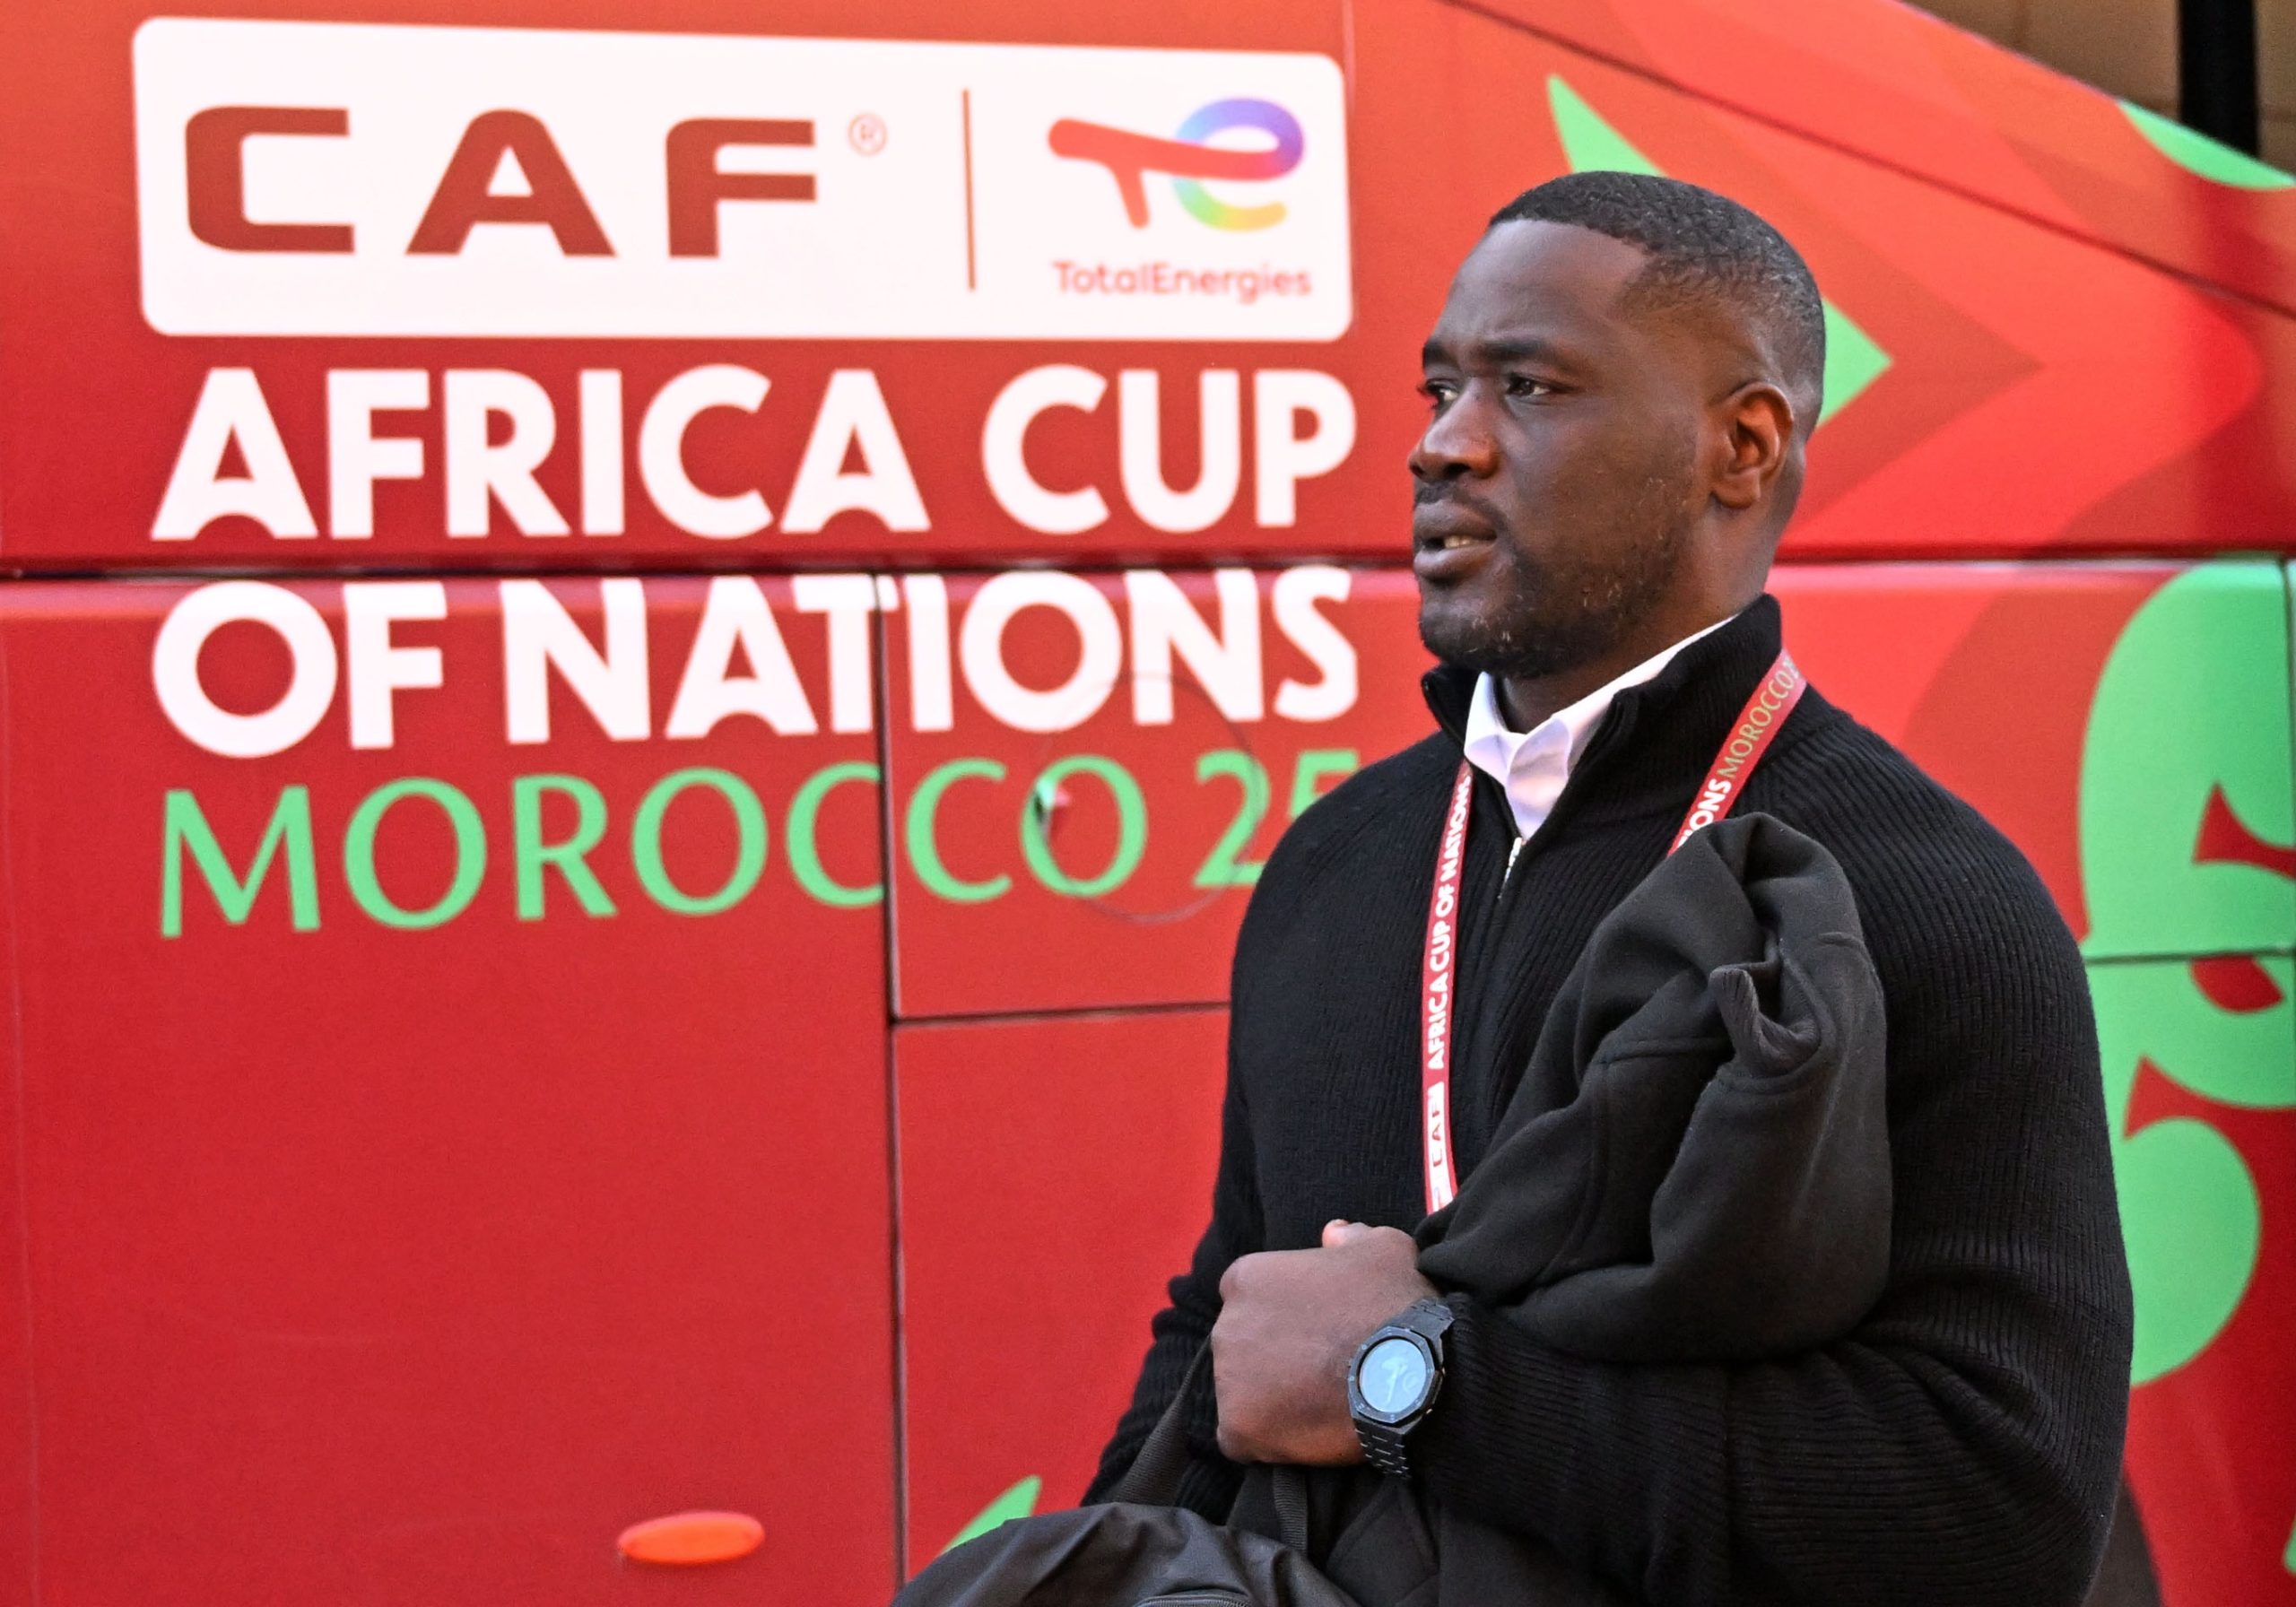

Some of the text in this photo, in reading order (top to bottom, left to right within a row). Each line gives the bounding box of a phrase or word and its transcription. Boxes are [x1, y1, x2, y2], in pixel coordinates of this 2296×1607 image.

[185, 105, 818, 258] CAF
[1053, 259, 1312, 305] TotalEnergies
[152, 364, 1355, 541] AFRICA CUP
[152, 565, 1359, 759] OF NATIONS
[1716, 669, 1795, 779] MOROCCO
[161, 756, 1146, 938] MOROCCO
[1427, 775, 1472, 1070] AFRICA CUP OF NATIONS
